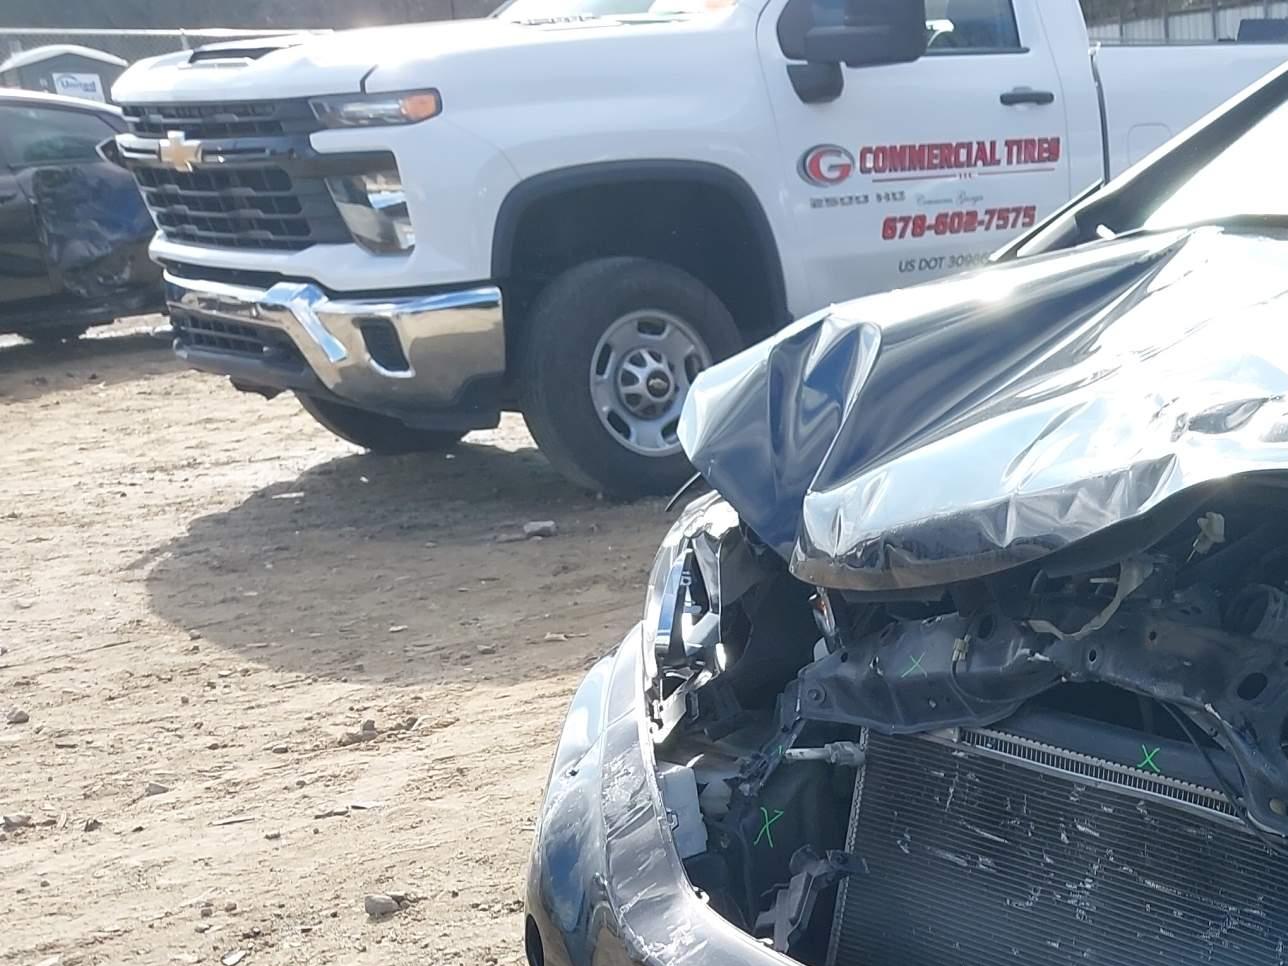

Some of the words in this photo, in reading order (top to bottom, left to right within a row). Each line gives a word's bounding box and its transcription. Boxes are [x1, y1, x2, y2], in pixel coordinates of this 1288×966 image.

[860, 139, 1001, 174] COMMERCIAL
[1004, 136, 1061, 166] TIRES
[810, 195, 869, 209] 2500
[882, 205, 1036, 241] 678-602-7575
[898, 258, 917, 274] US
[918, 256, 945, 271] DOT
